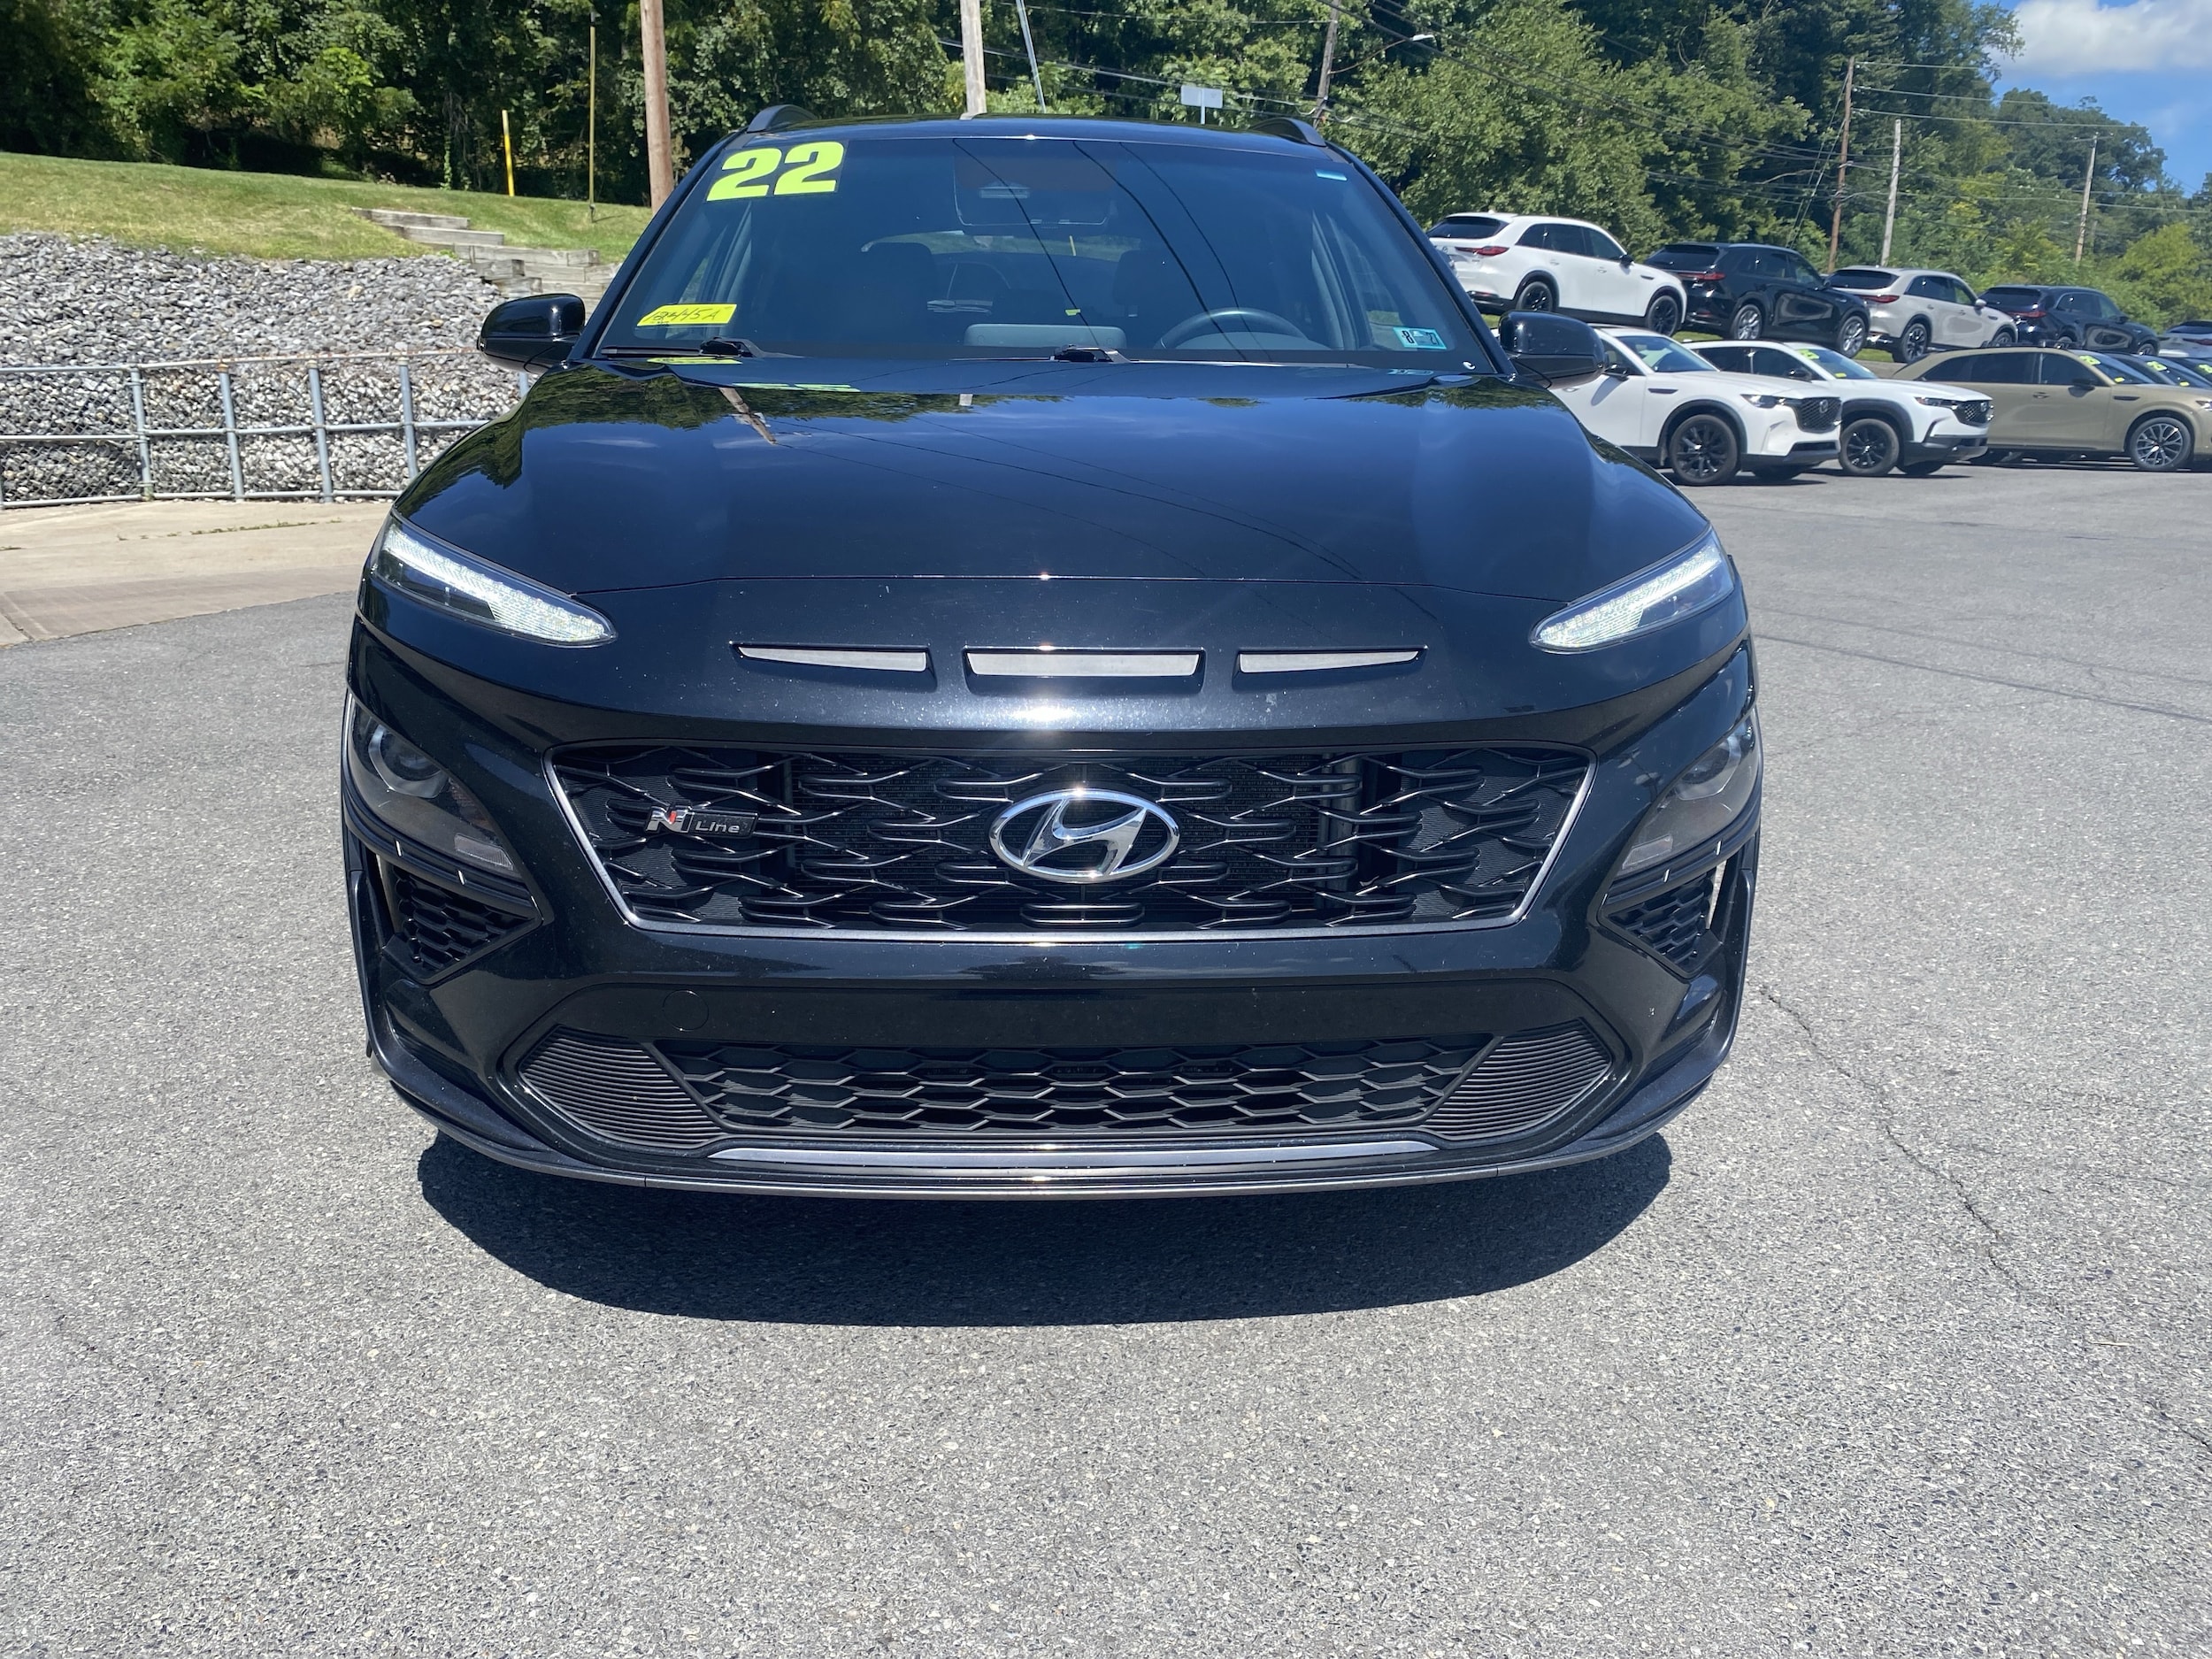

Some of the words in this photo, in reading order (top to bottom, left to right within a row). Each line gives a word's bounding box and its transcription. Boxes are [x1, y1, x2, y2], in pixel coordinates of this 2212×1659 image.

[707, 142, 844, 201] 22
[1402, 330, 1415, 344] 8
[645, 806, 692, 833] N
[695, 820, 740, 833] Line
